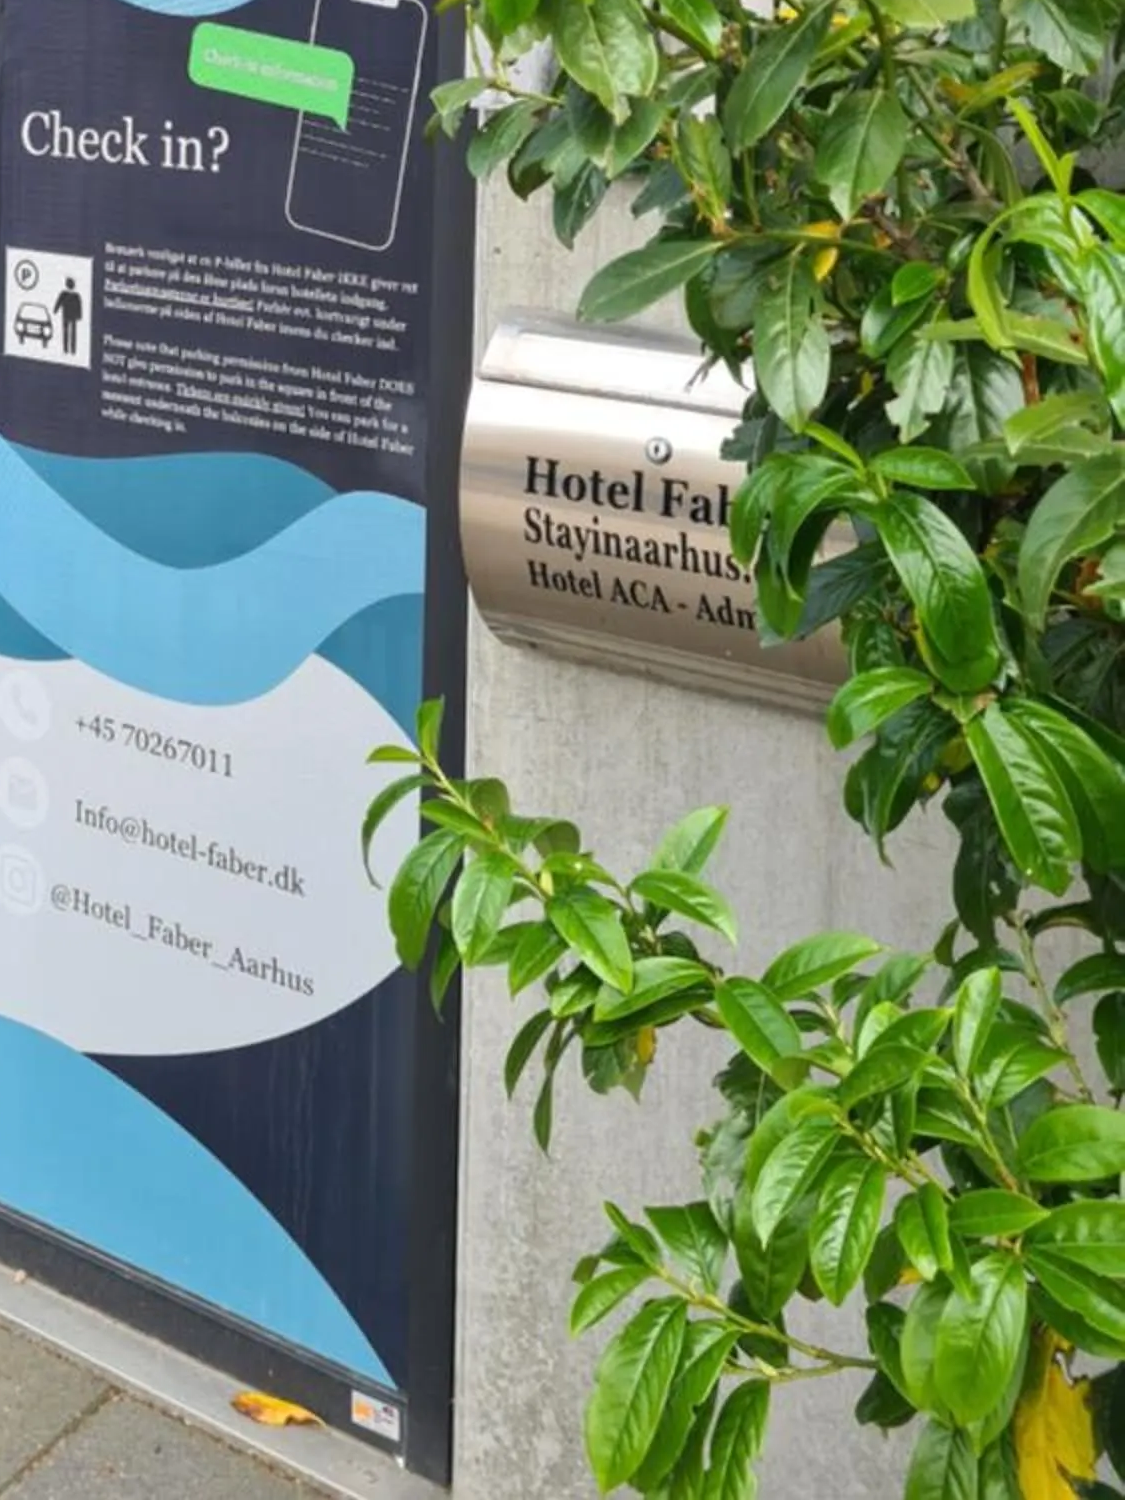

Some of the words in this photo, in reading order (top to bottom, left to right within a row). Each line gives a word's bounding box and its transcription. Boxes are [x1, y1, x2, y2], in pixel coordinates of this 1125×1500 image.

[21, 110, 150, 167] Check
[161, 120, 230, 173] in?
[524, 456, 644, 512] Hotel
[524, 507, 752, 583] Stayinaarhus.
[527, 559, 602, 599] Hotel
[610, 577, 671, 614] ACA
[75, 715, 116, 743] +45
[122, 723, 234, 777] 70267011
[75, 799, 307, 897] Info@hotel-faber.dk
[50, 883, 315, 996] @Hotel_Faber_Aarhus
